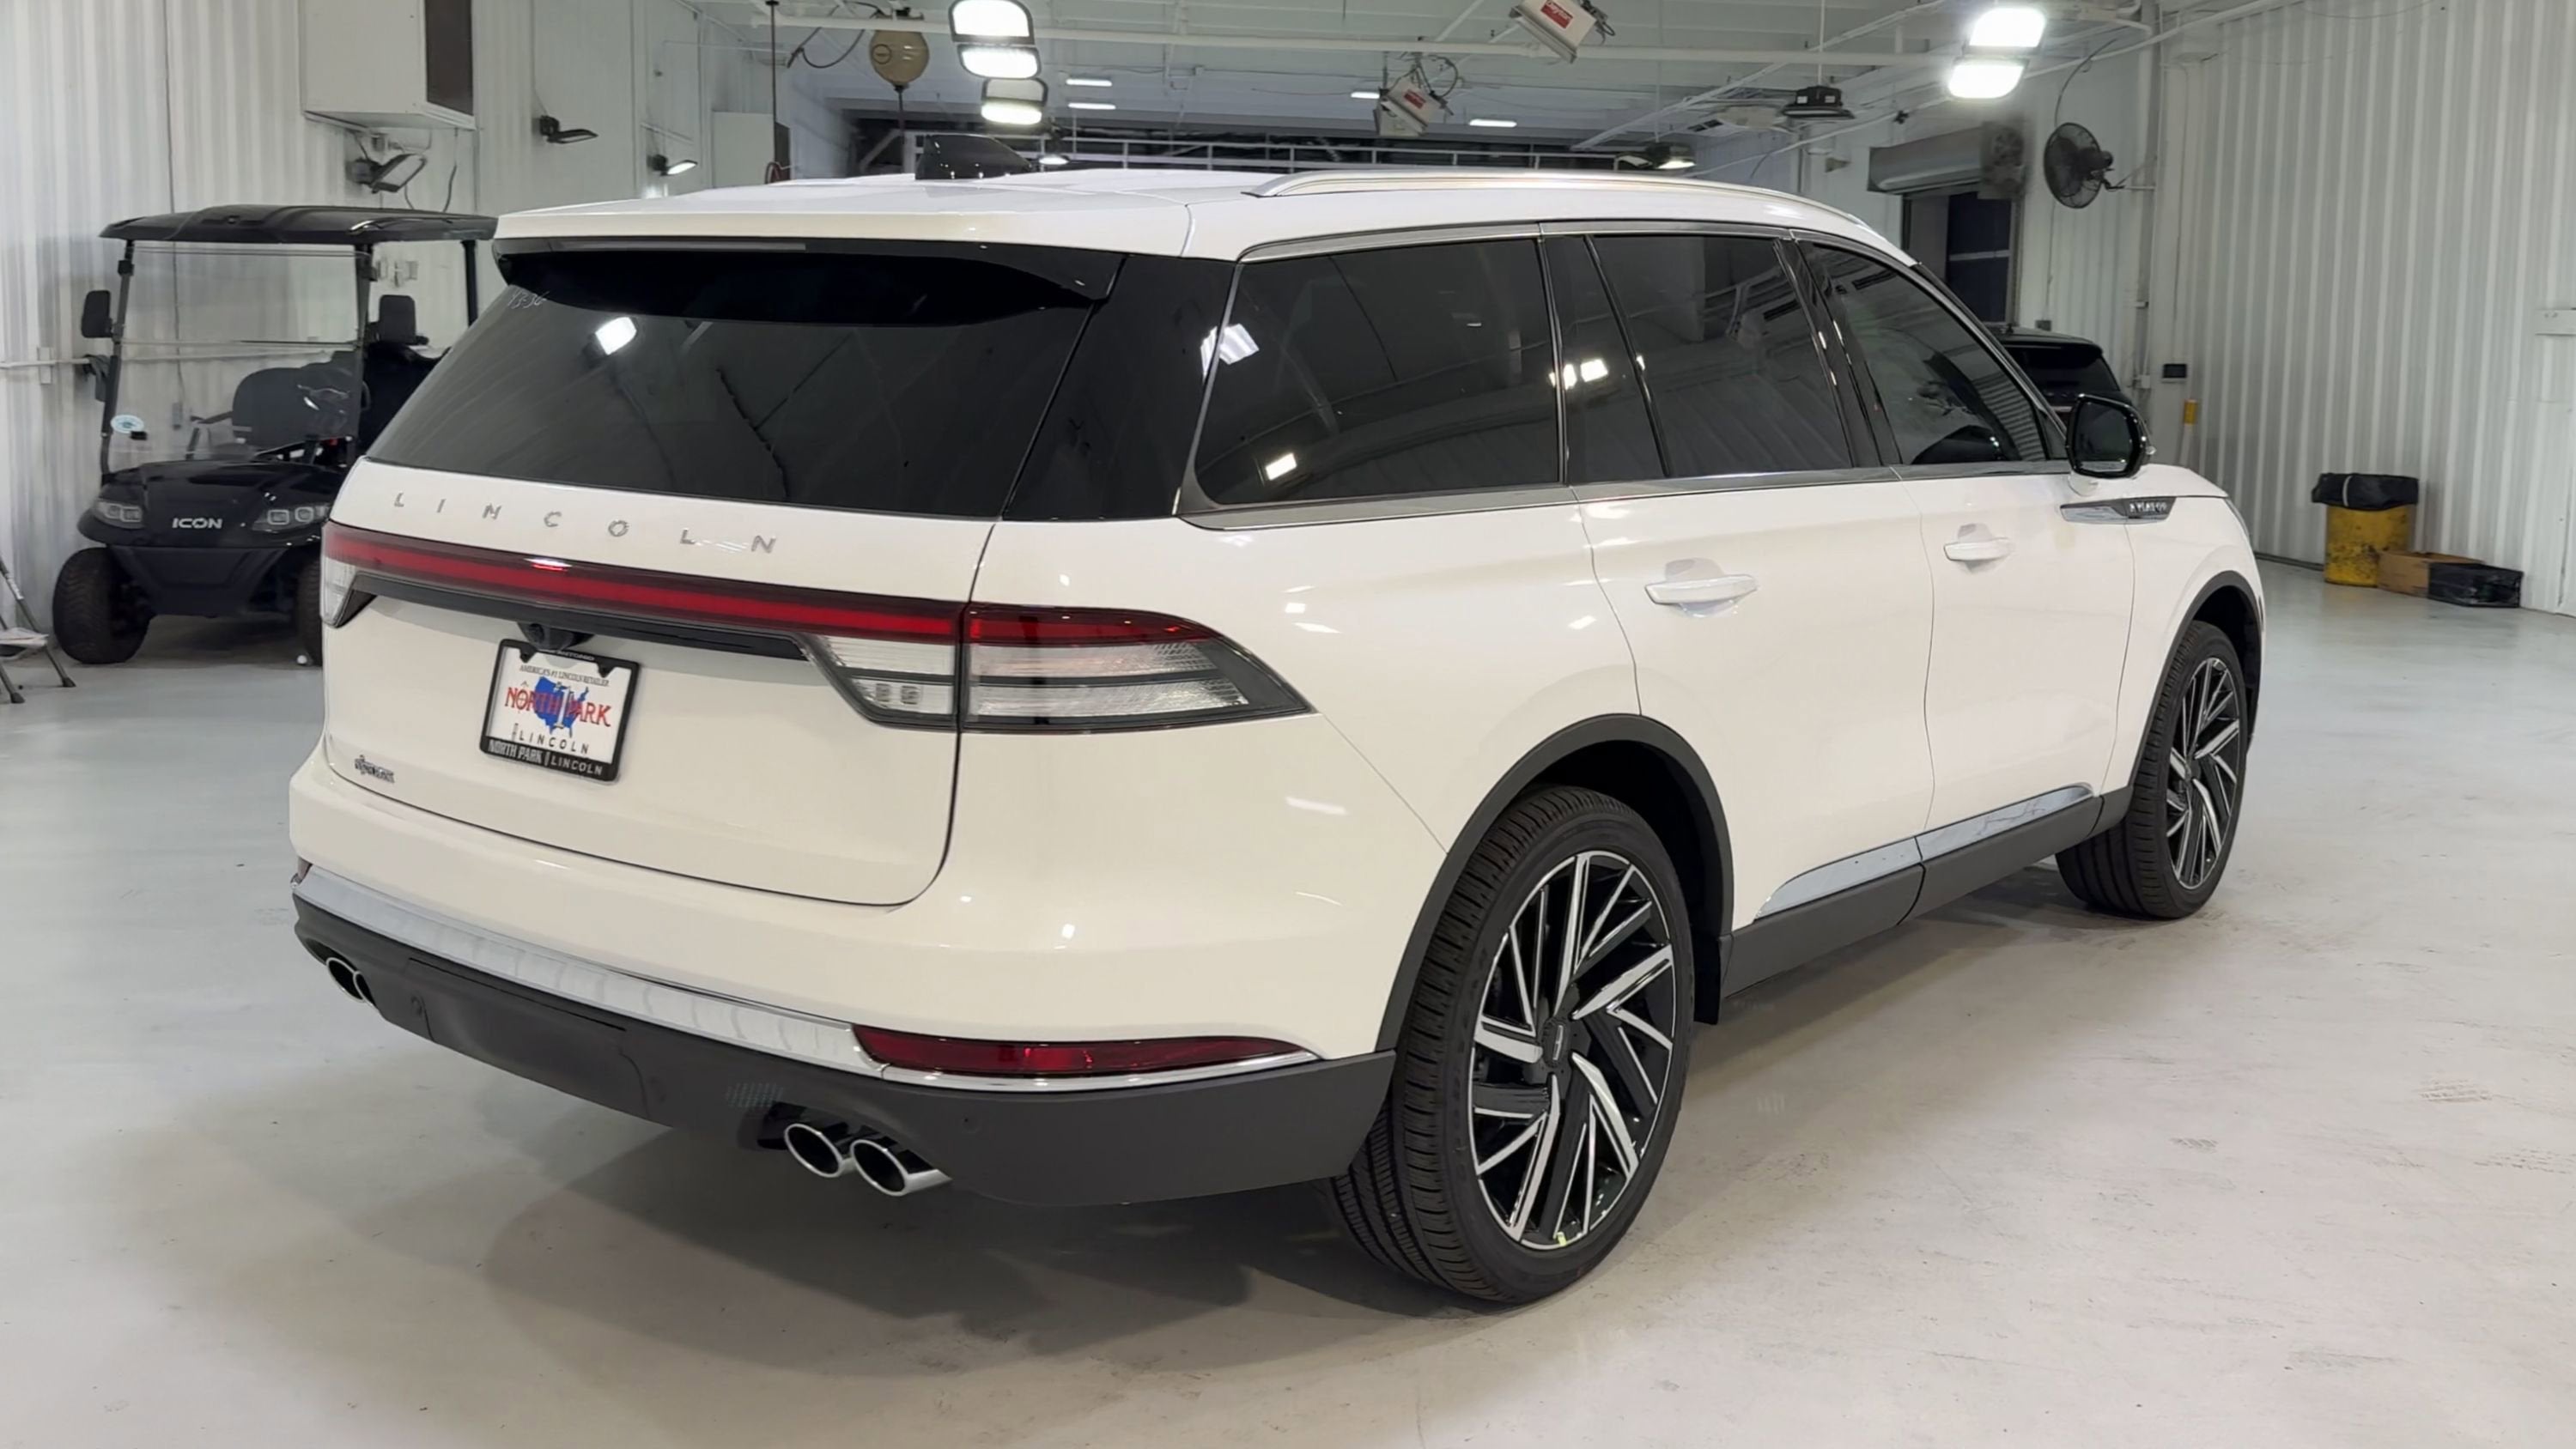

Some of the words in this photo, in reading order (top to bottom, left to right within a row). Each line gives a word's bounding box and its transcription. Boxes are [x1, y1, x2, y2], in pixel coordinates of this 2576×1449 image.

[172, 518, 222, 529] ICON
[393, 492, 777, 554] LINCOLN
[558, 671, 583, 682] LINCOLN
[504, 686, 561, 715] NORTH
[566, 696, 612, 728] PARK
[488, 738, 517, 757] NORTH
[517, 744, 544, 764] PARK
[550, 755, 603, 775] LINCOLN
[519, 730, 589, 755] LINCOLN
